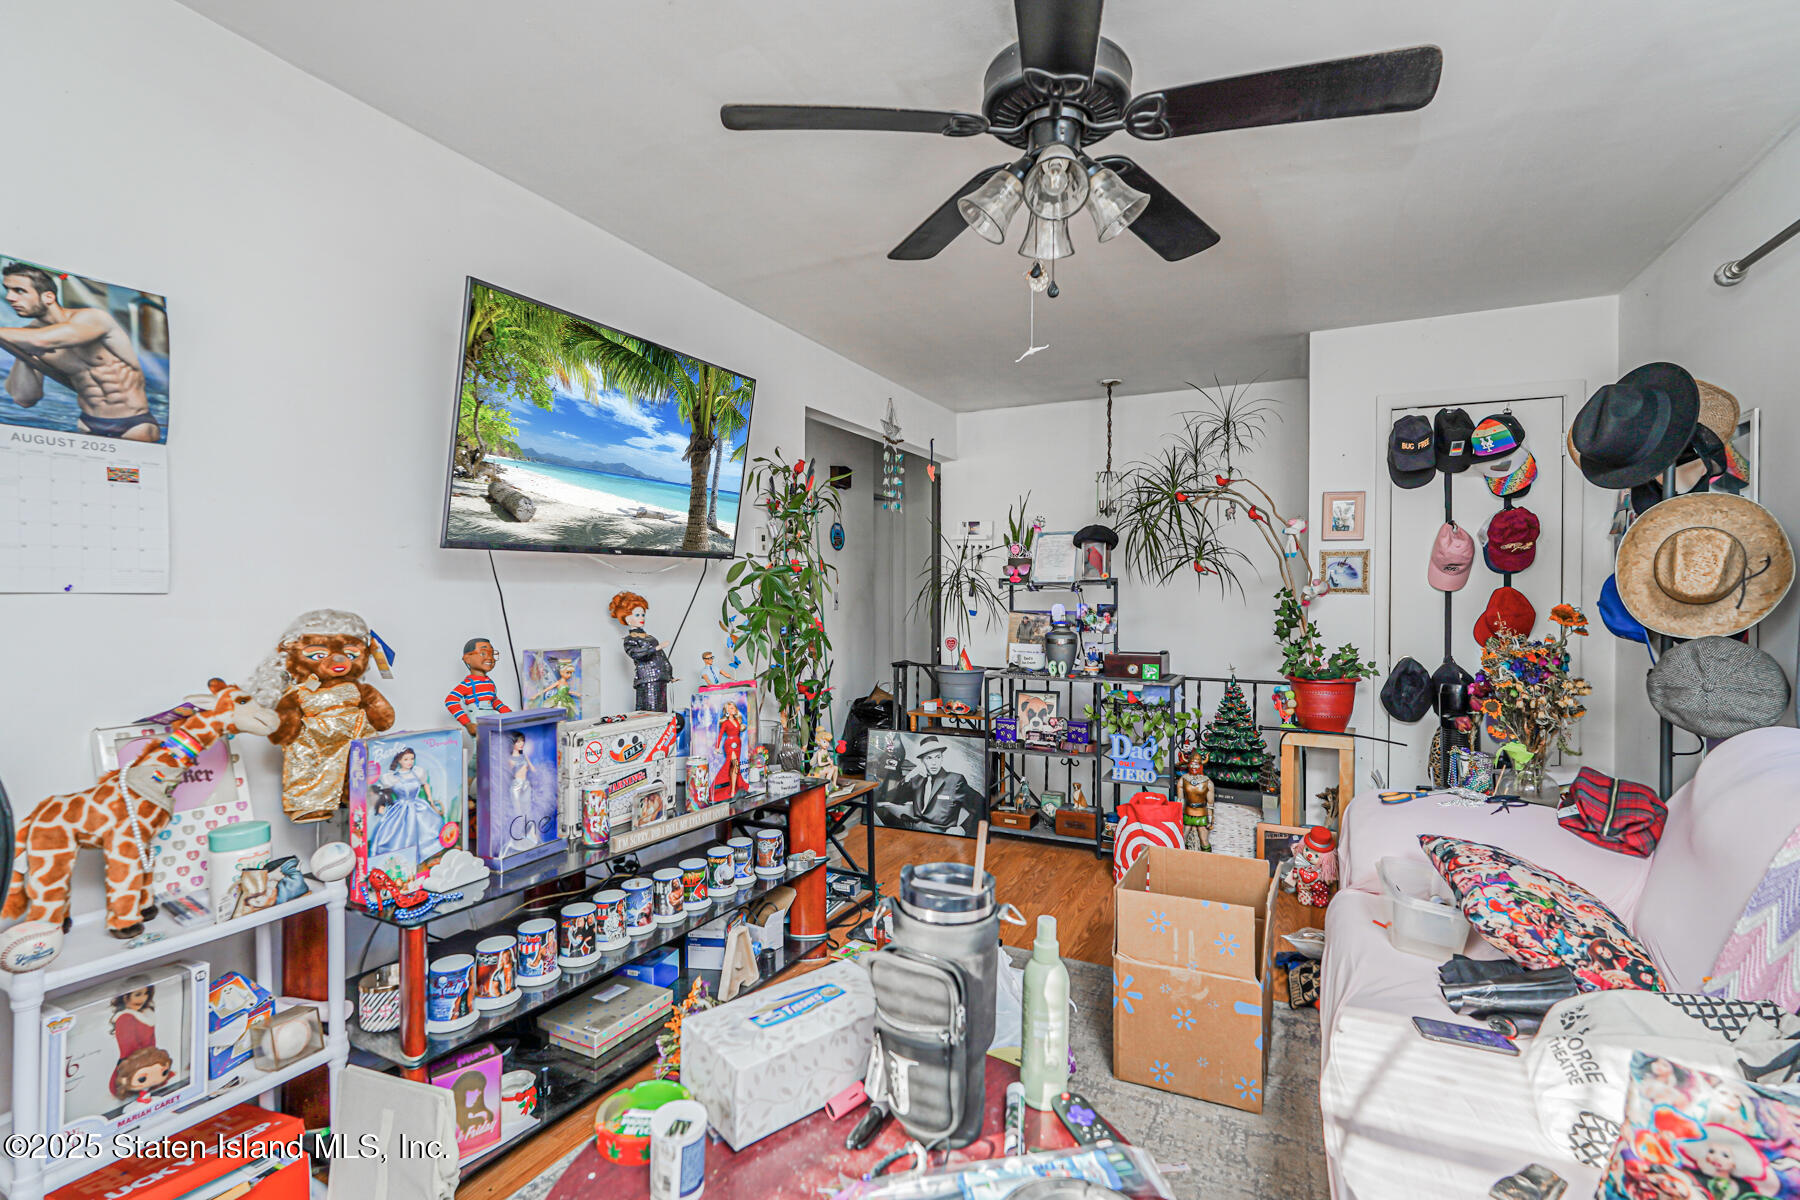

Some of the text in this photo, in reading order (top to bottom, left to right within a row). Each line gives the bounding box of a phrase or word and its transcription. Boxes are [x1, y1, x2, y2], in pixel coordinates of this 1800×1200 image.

[11, 432, 117, 453] AUGUST 2025
[1401, 437, 1430, 450] BUG FREE
[1109, 733, 1159, 761] Dad
[1112, 767, 1157, 784] HERO
[1567, 1037, 1608, 1084] ORGE
[117, 1095, 181, 1128] MARIAH CAREY
[465, 1119, 497, 1141] Friday
[104, 1157, 196, 1200] UCKY
